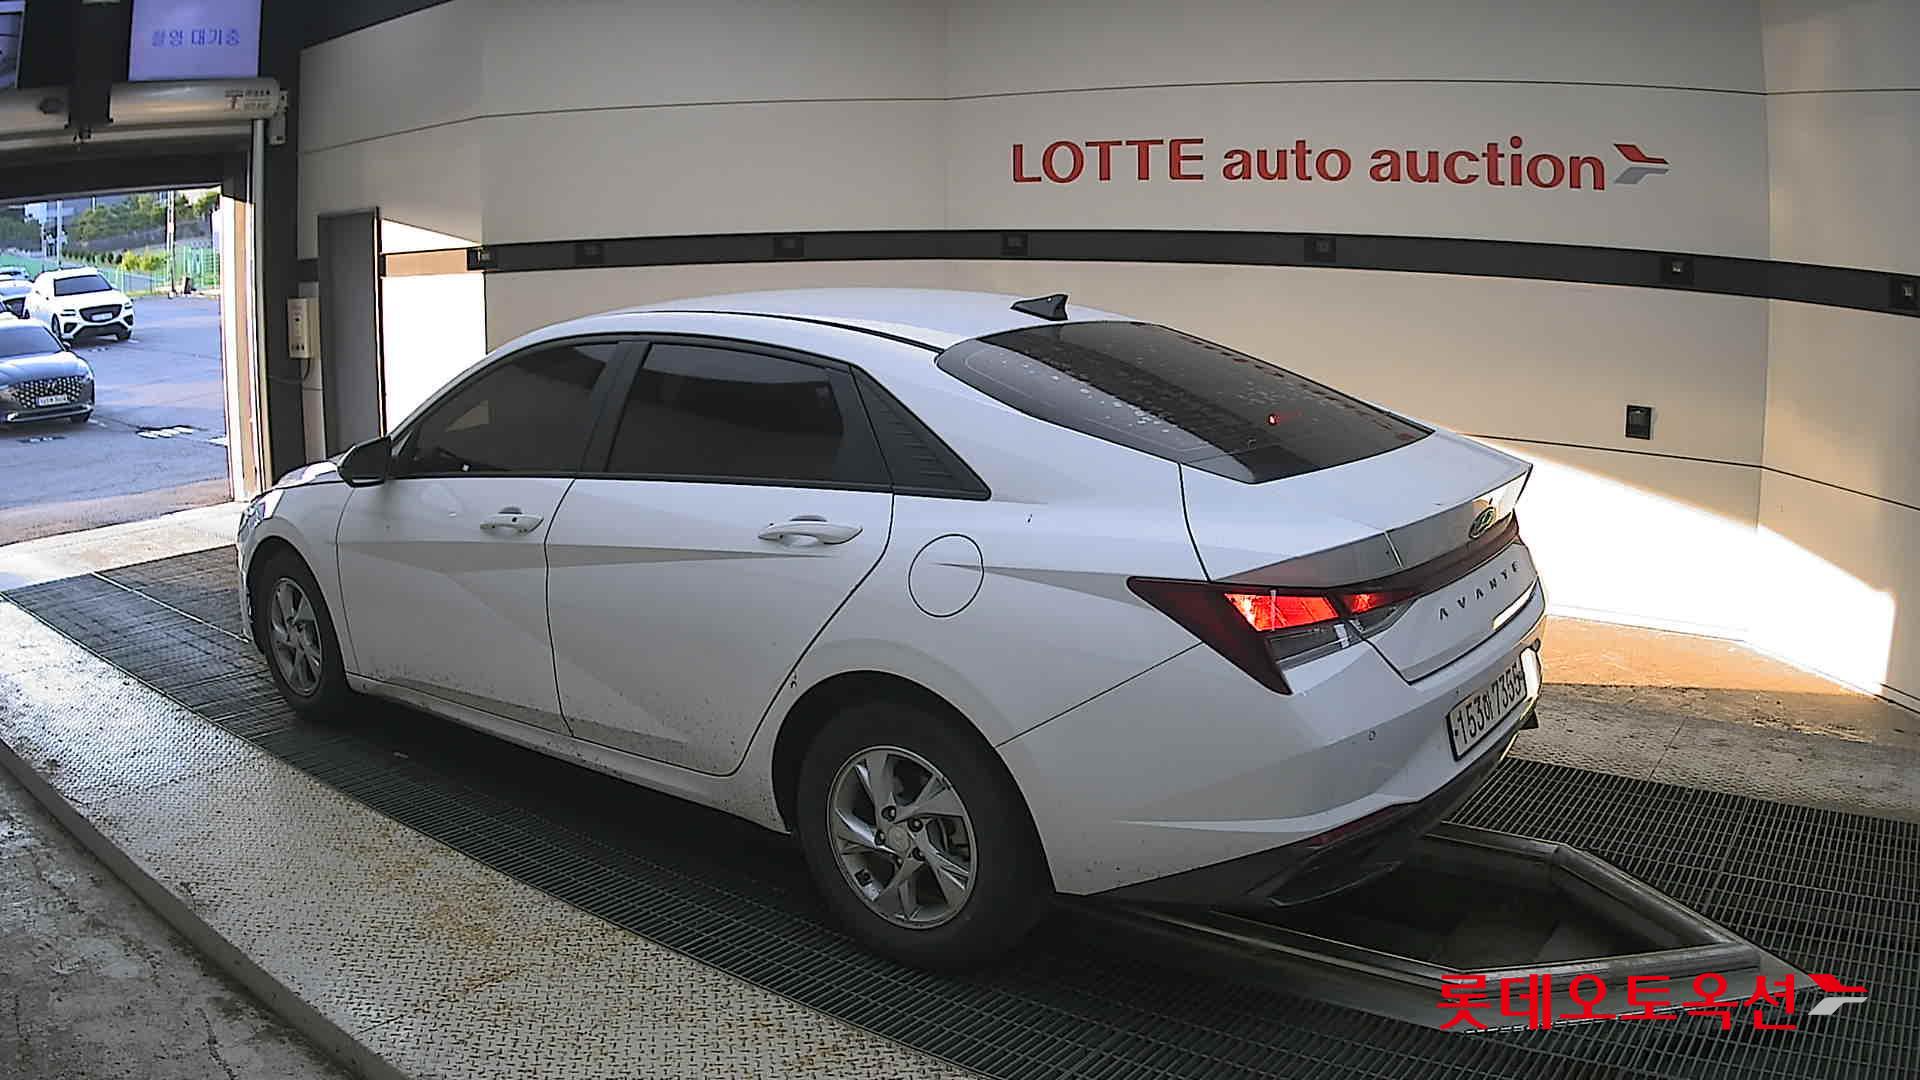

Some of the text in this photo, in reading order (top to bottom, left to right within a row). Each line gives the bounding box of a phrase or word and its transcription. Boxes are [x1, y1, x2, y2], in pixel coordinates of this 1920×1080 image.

[191, 27, 241, 47] 대기중
[1012, 136, 1606, 191] LOTTE auto auction
[1439, 560, 1520, 620] AVANTE
